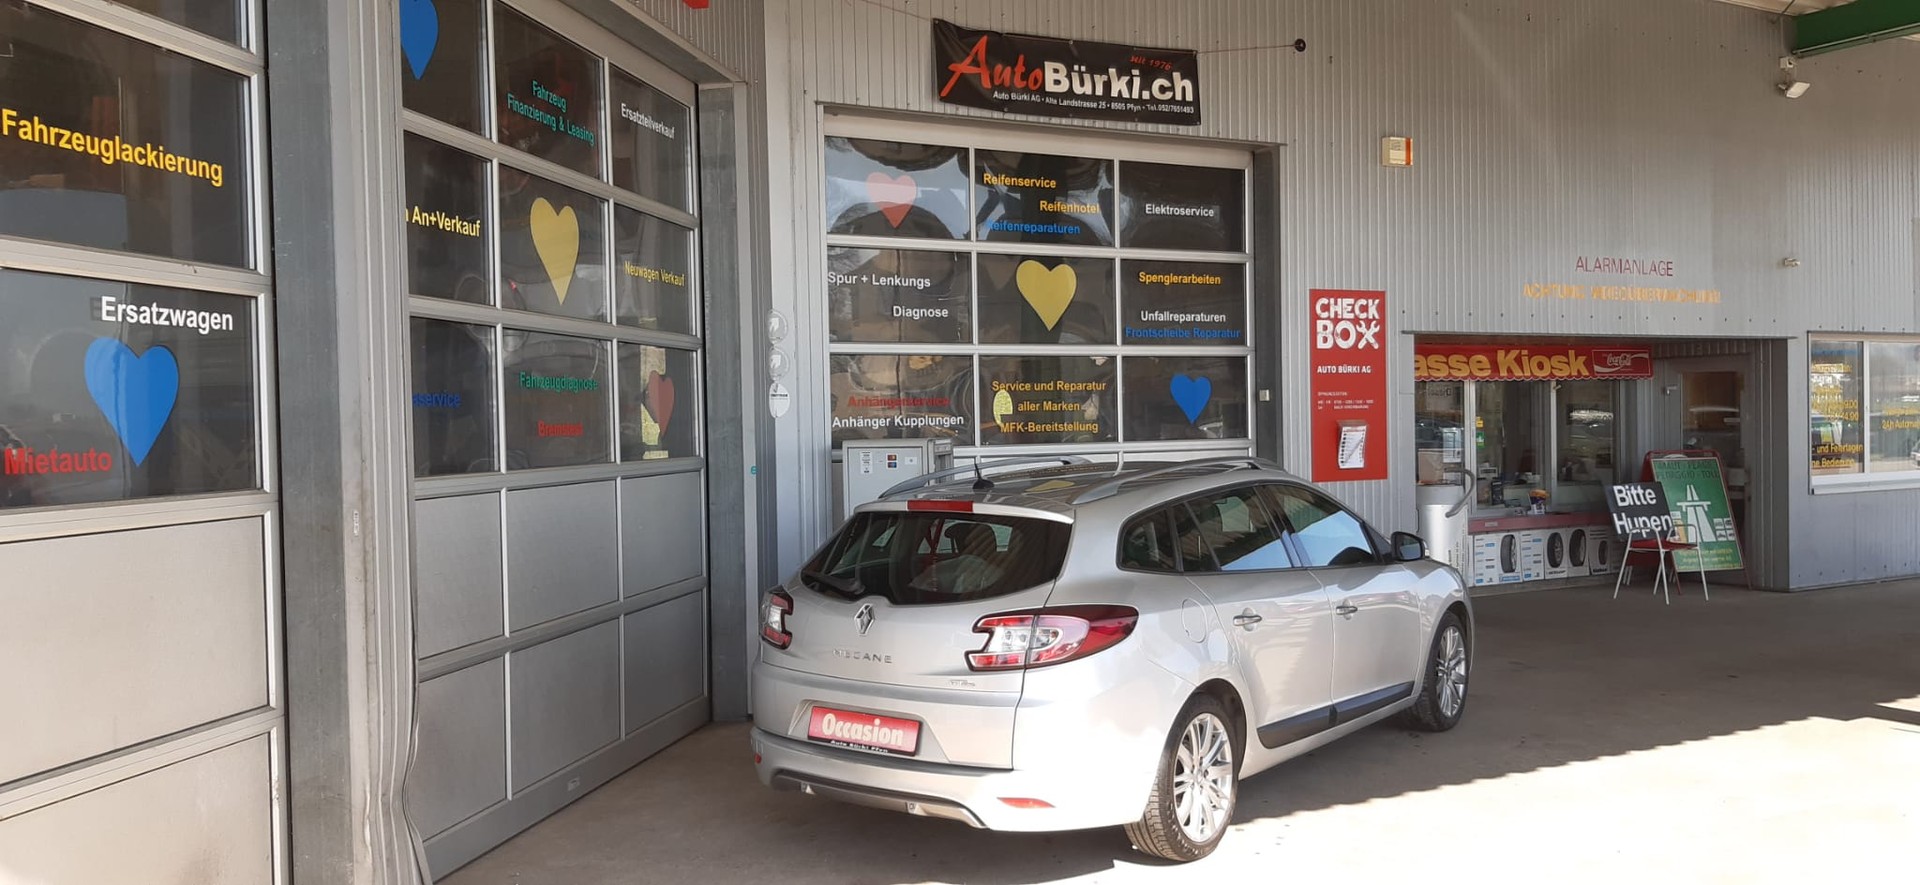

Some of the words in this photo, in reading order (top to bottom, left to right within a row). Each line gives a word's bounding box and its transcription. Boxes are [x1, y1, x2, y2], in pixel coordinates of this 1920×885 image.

[532, 80, 568, 113] Fahrzeug
[993, 91, 1010, 100] Auto
[1011, 91, 1030, 101] Bürki
[1030, 94, 1041, 103] AG
[1058, 97, 1097, 109] Landstrasse
[1098, 101, 1107, 109] 25
[1126, 102, 1142, 112] Pfyn
[507, 93, 557, 131] Finanzierung
[558, 117, 565, 132] &
[567, 119, 596, 147] Leasing
[621, 103, 676, 139] Ersatzteilverkauf
[1, 107, 224, 188] Fahrzeuglackierung
[983, 172, 1057, 189] Reifenservice
[1039, 200, 1100, 214] Reifenhotel
[1145, 203, 1215, 218] Elektroservice
[412, 206, 481, 238] An+Verkauf
[987, 220, 1081, 236] Reifenreparaturen
[624, 260, 660, 283] Neuwagen
[660, 269, 686, 287] Verkauf
[1575, 256, 1673, 277] ALARMANLAGE
[827, 272, 858, 285] Spur
[861, 275, 868, 283] +
[872, 273, 931, 290] Lenkungs
[1139, 271, 1221, 286] Spenglerarbeiten
[101, 295, 234, 335] Ersatzwagen
[892, 305, 949, 320] Diagnose
[1140, 310, 1226, 324] Unfallreparaturen
[1315, 297, 1380, 320] CHECK
[1125, 326, 1191, 338] Frontscheibe
[1193, 327, 1241, 340] Reparatur
[1316, 319, 1381, 350] BOX
[1317, 365, 1337, 374] AUTO
[1338, 363, 1360, 374] BÜRKI
[1361, 365, 1372, 374] AG
[1496, 349, 1590, 377] Kiosk
[519, 371, 599, 394] Fahrzeugdiagnose
[991, 380, 1032, 392] Service
[1034, 380, 1054, 392] und
[1057, 380, 1107, 394] Reparatur
[1017, 399, 1040, 412] aller
[1043, 399, 1081, 412] Marken
[832, 416, 891, 430] Anhänger
[894, 414, 965, 430] Kupplungen
[1000, 420, 1099, 434] MFK-Bereitstellung
[4, 447, 113, 476] Mietauto
[1613, 484, 1657, 507] Bitte
[1612, 512, 1673, 538] Hupen
[822, 713, 905, 746] Occasion
